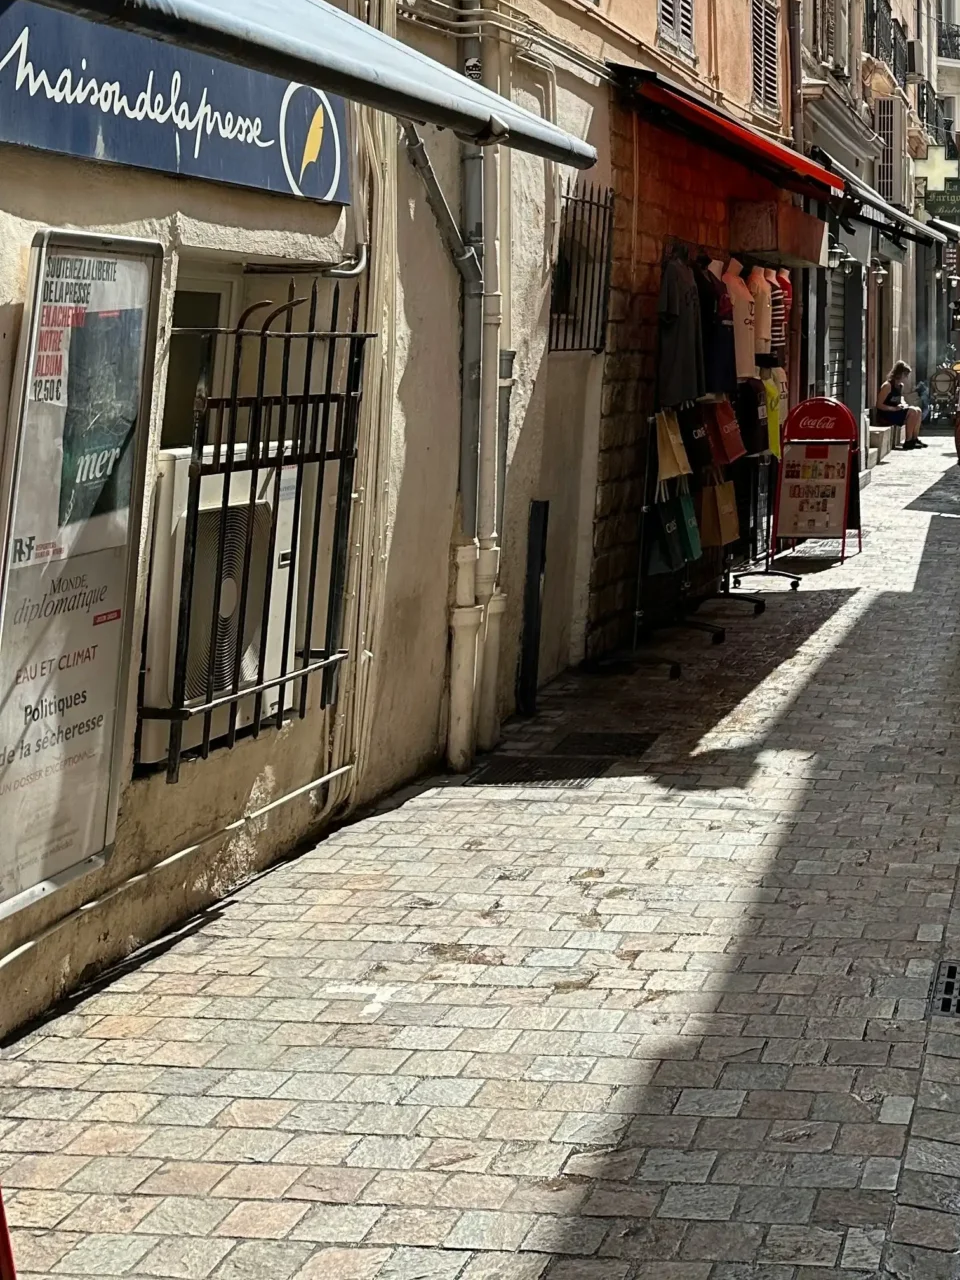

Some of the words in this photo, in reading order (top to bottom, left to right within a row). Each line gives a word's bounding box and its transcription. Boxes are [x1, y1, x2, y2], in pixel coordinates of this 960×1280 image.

[945, 181, 959, 194] La
[46, 256, 83, 280] SOUTENEZ
[82, 258, 92, 280] LA
[91, 258, 118, 282] LIBERTÉ
[43, 280, 54, 303] DE
[54, 280, 64, 303] LA
[64, 281, 92, 304] PRESSE
[38, 329, 64, 352] NOTRE
[35, 354, 63, 377] ALBUM
[55, 378, 62, 401] €
[76, 447, 120, 484] mer
[13, 536, 36, 563] RSF
[13, 585, 108, 628] diplomatique
[15, 664, 38, 686] EAU
[40, 658, 56, 677] ET
[57, 644, 99, 671] CLIMAT
[24, 689, 87, 726] Politiques
[19, 739, 32, 760] la
[34, 714, 104, 753] sécheresse
